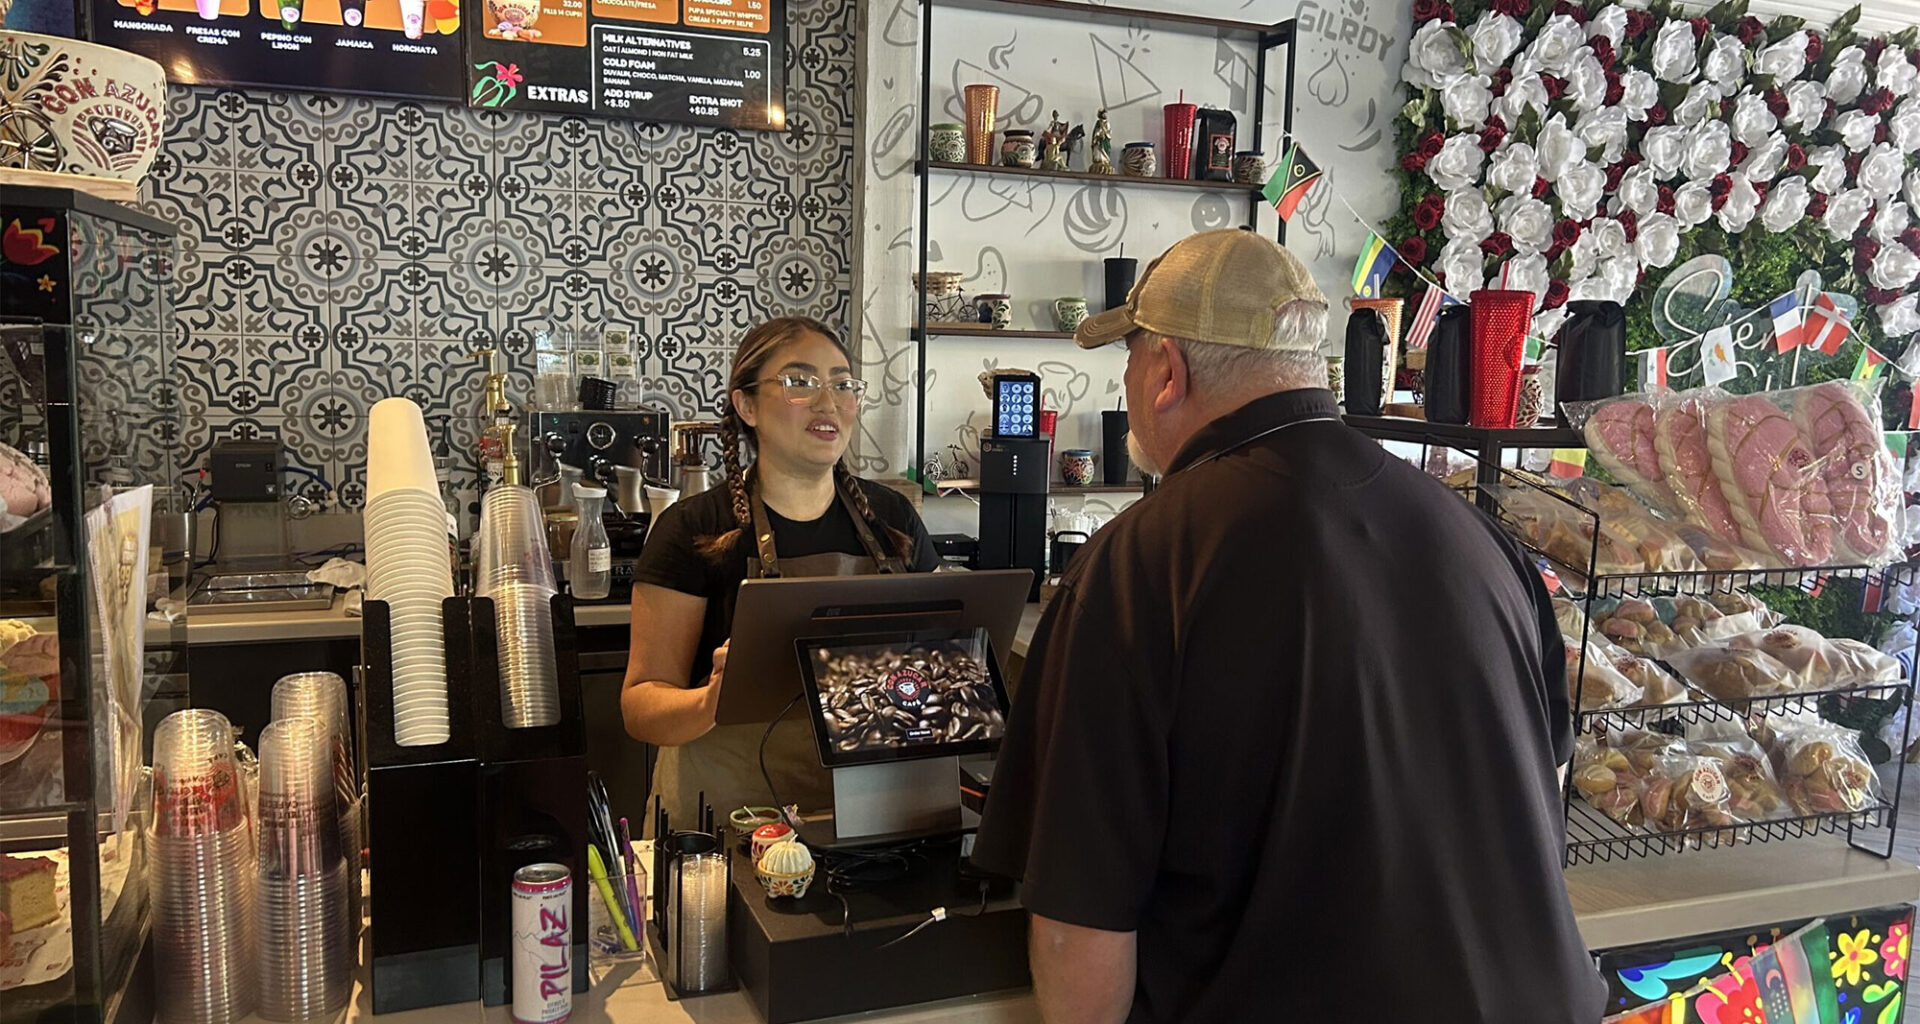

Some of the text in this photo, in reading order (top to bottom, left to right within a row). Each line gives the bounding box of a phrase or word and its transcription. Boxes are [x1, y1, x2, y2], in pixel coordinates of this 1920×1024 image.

[747, 1, 762, 9] 1.50
[688, 15, 711, 23] CREAM
[705, 8, 736, 18] SPECIALTY
[736, 12, 764, 20] WHIPPED
[113, 20, 174, 33] MANGONADA
[186, 26, 241, 39] FRESAS CON
[1294, 0, 1396, 62] GILROY
[197, 36, 229, 46] CREMA
[261, 32, 312, 44] PEPINO CON
[336, 39, 374, 49] JAMAICA
[602, 33, 692, 50] MILK ALTERNATIVES
[272, 42, 300, 51] LIMON
[392, 44, 438, 55] HORCHATA
[602, 45, 617, 53] OAT
[621, 47, 648, 56] ALMOND
[652, 50, 667, 58] NON
[743, 47, 761, 57] 5.25
[602, 57, 656, 70] COLD FOAM
[632, 71, 658, 80] CHOCO,
[658, 74, 687, 83] MATCHA,
[687, 76, 713, 85] VANILLA,
[744, 70, 761, 79] 1.00
[603, 77, 630, 86] BANANA
[527, 85, 589, 104] EXTRAS
[604, 88, 654, 100] ADD SYRUP
[604, 99, 630, 108] +$.50
[689, 95, 744, 108] EXTRA SHOT
[40, 77, 160, 149] CON AZUCAR
[689, 106, 719, 116] +$0.85
[1855, 465, 1863, 477] S
[539, 904, 570, 1001] PILAZ
